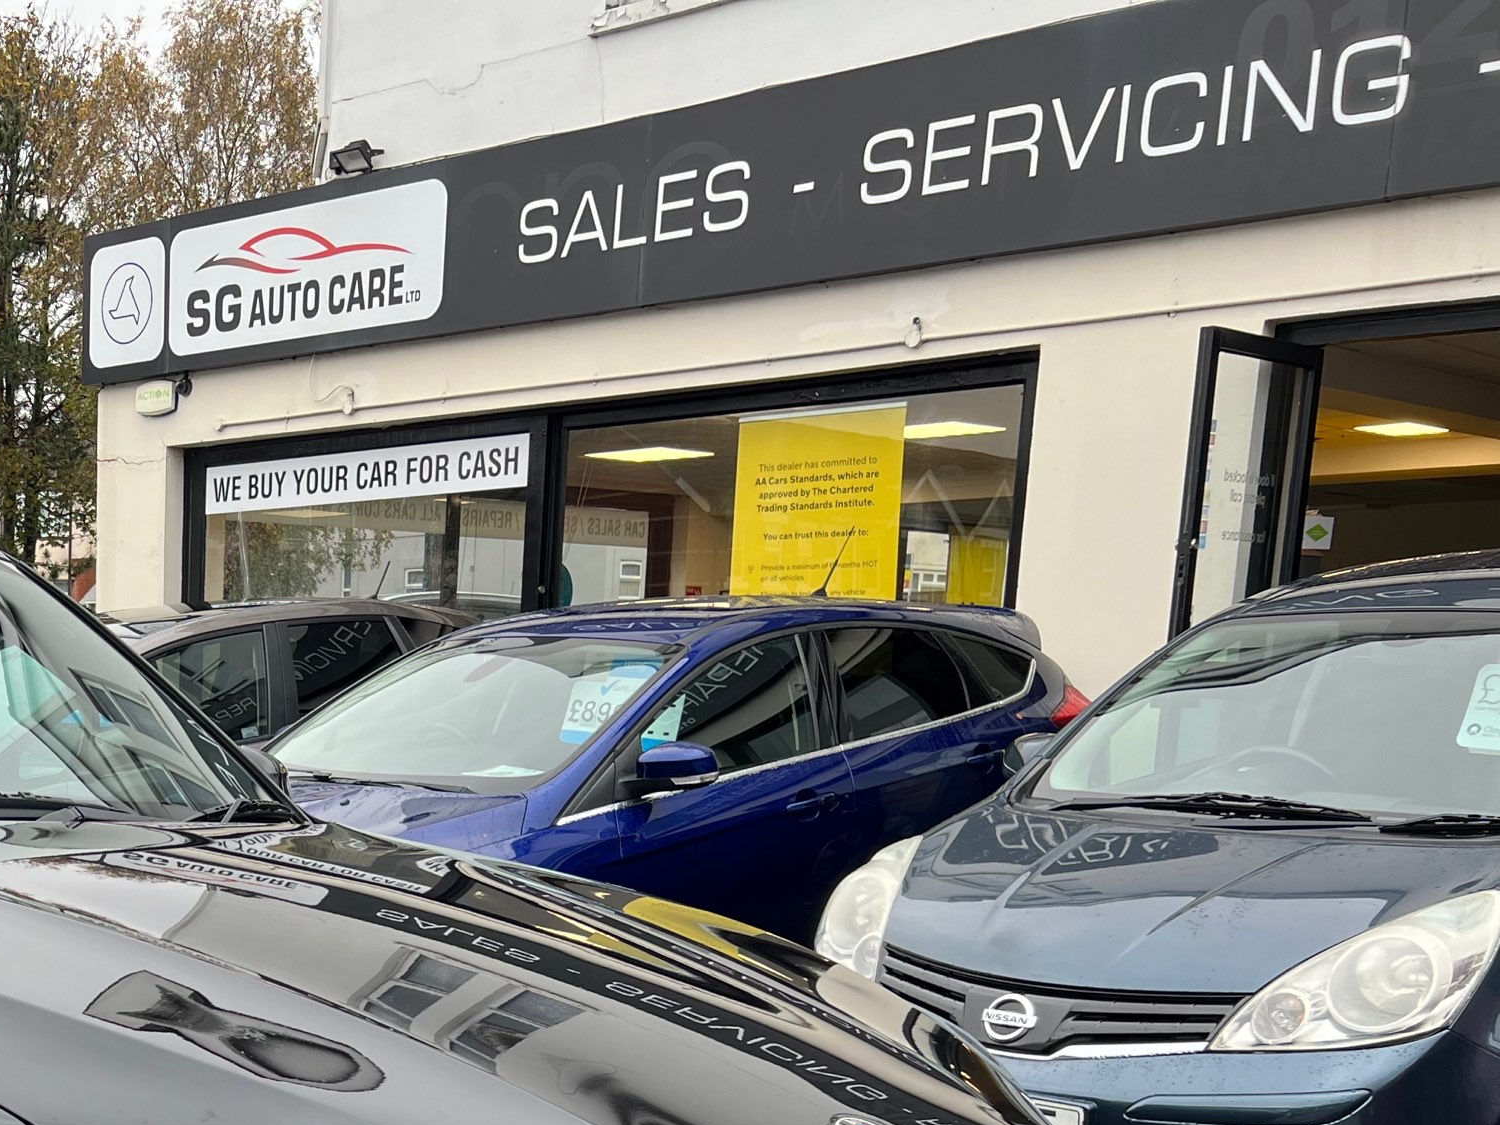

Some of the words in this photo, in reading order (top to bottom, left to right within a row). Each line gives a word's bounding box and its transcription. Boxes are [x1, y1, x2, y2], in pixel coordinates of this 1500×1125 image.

[516, 158, 750, 265] SALES
[859, 33, 1412, 206] SERVICING
[186, 283, 242, 338] SG
[248, 279, 320, 329] AUTO
[328, 263, 405, 315] CARE
[405, 289, 421, 304] LTD
[759, 463, 775, 473] This
[776, 462, 803, 472] dealer
[804, 460, 819, 470] has
[820, 457, 866, 469] committed
[868, 456, 878, 465] to
[213, 475, 242, 503] WE
[249, 471, 287, 500] BUY
[294, 464, 348, 496] YOUR
[356, 459, 398, 490] CAR
[406, 453, 450, 485] FOR
[457, 446, 520, 481] CASH
[755, 477, 767, 486] AA
[768, 476, 788, 486] Cars
[789, 473, 836, 485] Standards,
[837, 471, 864, 481] which
[866, 471, 880, 479] are
[758, 489, 799, 500] approved
[800, 489, 811, 499] by
[812, 487, 828, 496] The
[829, 484, 874, 495] Chartered
[756, 504, 788, 513] Trading
[789, 500, 833, 511] Standards
[835, 498, 875, 508] Institute.
[763, 532, 777, 541] You
[794, 530, 813, 540] trust
[814, 529, 829, 538] this
[830, 529, 857, 538] dealer
[760, 564, 785, 572] Provide
[861, 560, 878, 568] MOT
[778, 574, 804, 582] vehicles
[985, 1011, 1028, 1025] NISSAN
